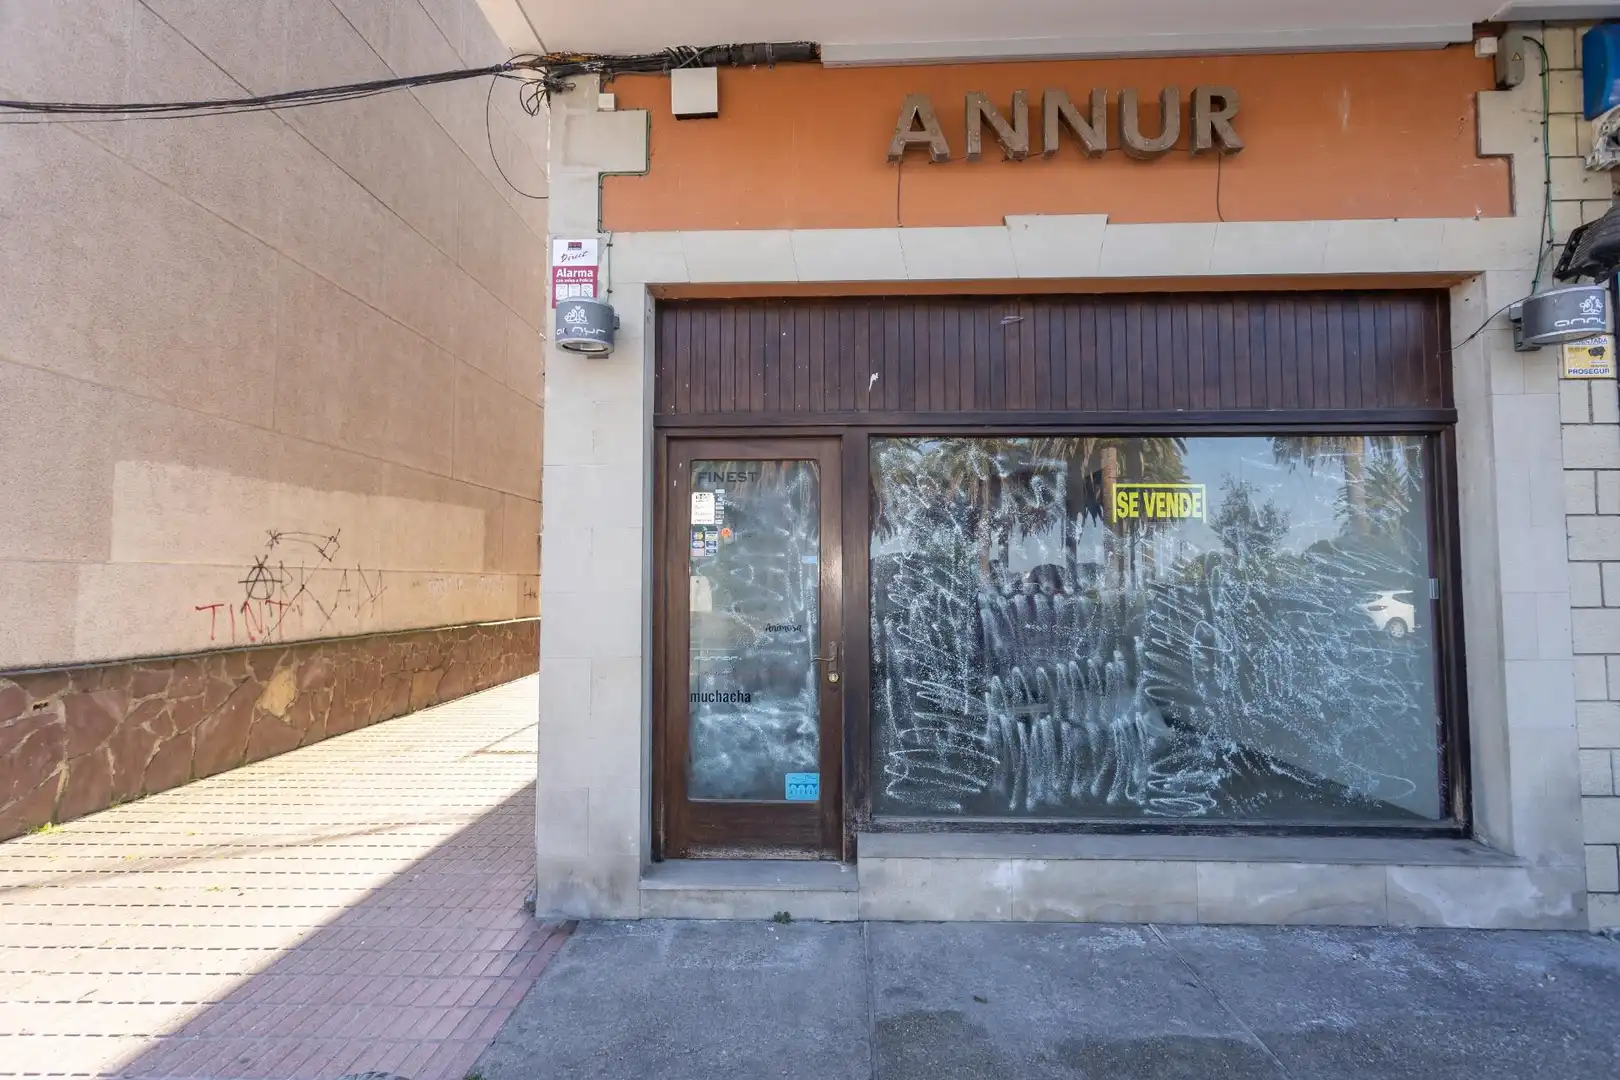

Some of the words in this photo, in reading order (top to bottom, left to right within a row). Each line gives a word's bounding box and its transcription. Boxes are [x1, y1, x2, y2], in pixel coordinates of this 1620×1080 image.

[886, 85, 1244, 166] ANNUR
[556, 268, 593, 277] Alarma
[697, 471, 758, 484] FINEST
[1117, 491, 1139, 518] SE
[1143, 491, 1203, 518] VENDE
[690, 689, 752, 703] muchacha
